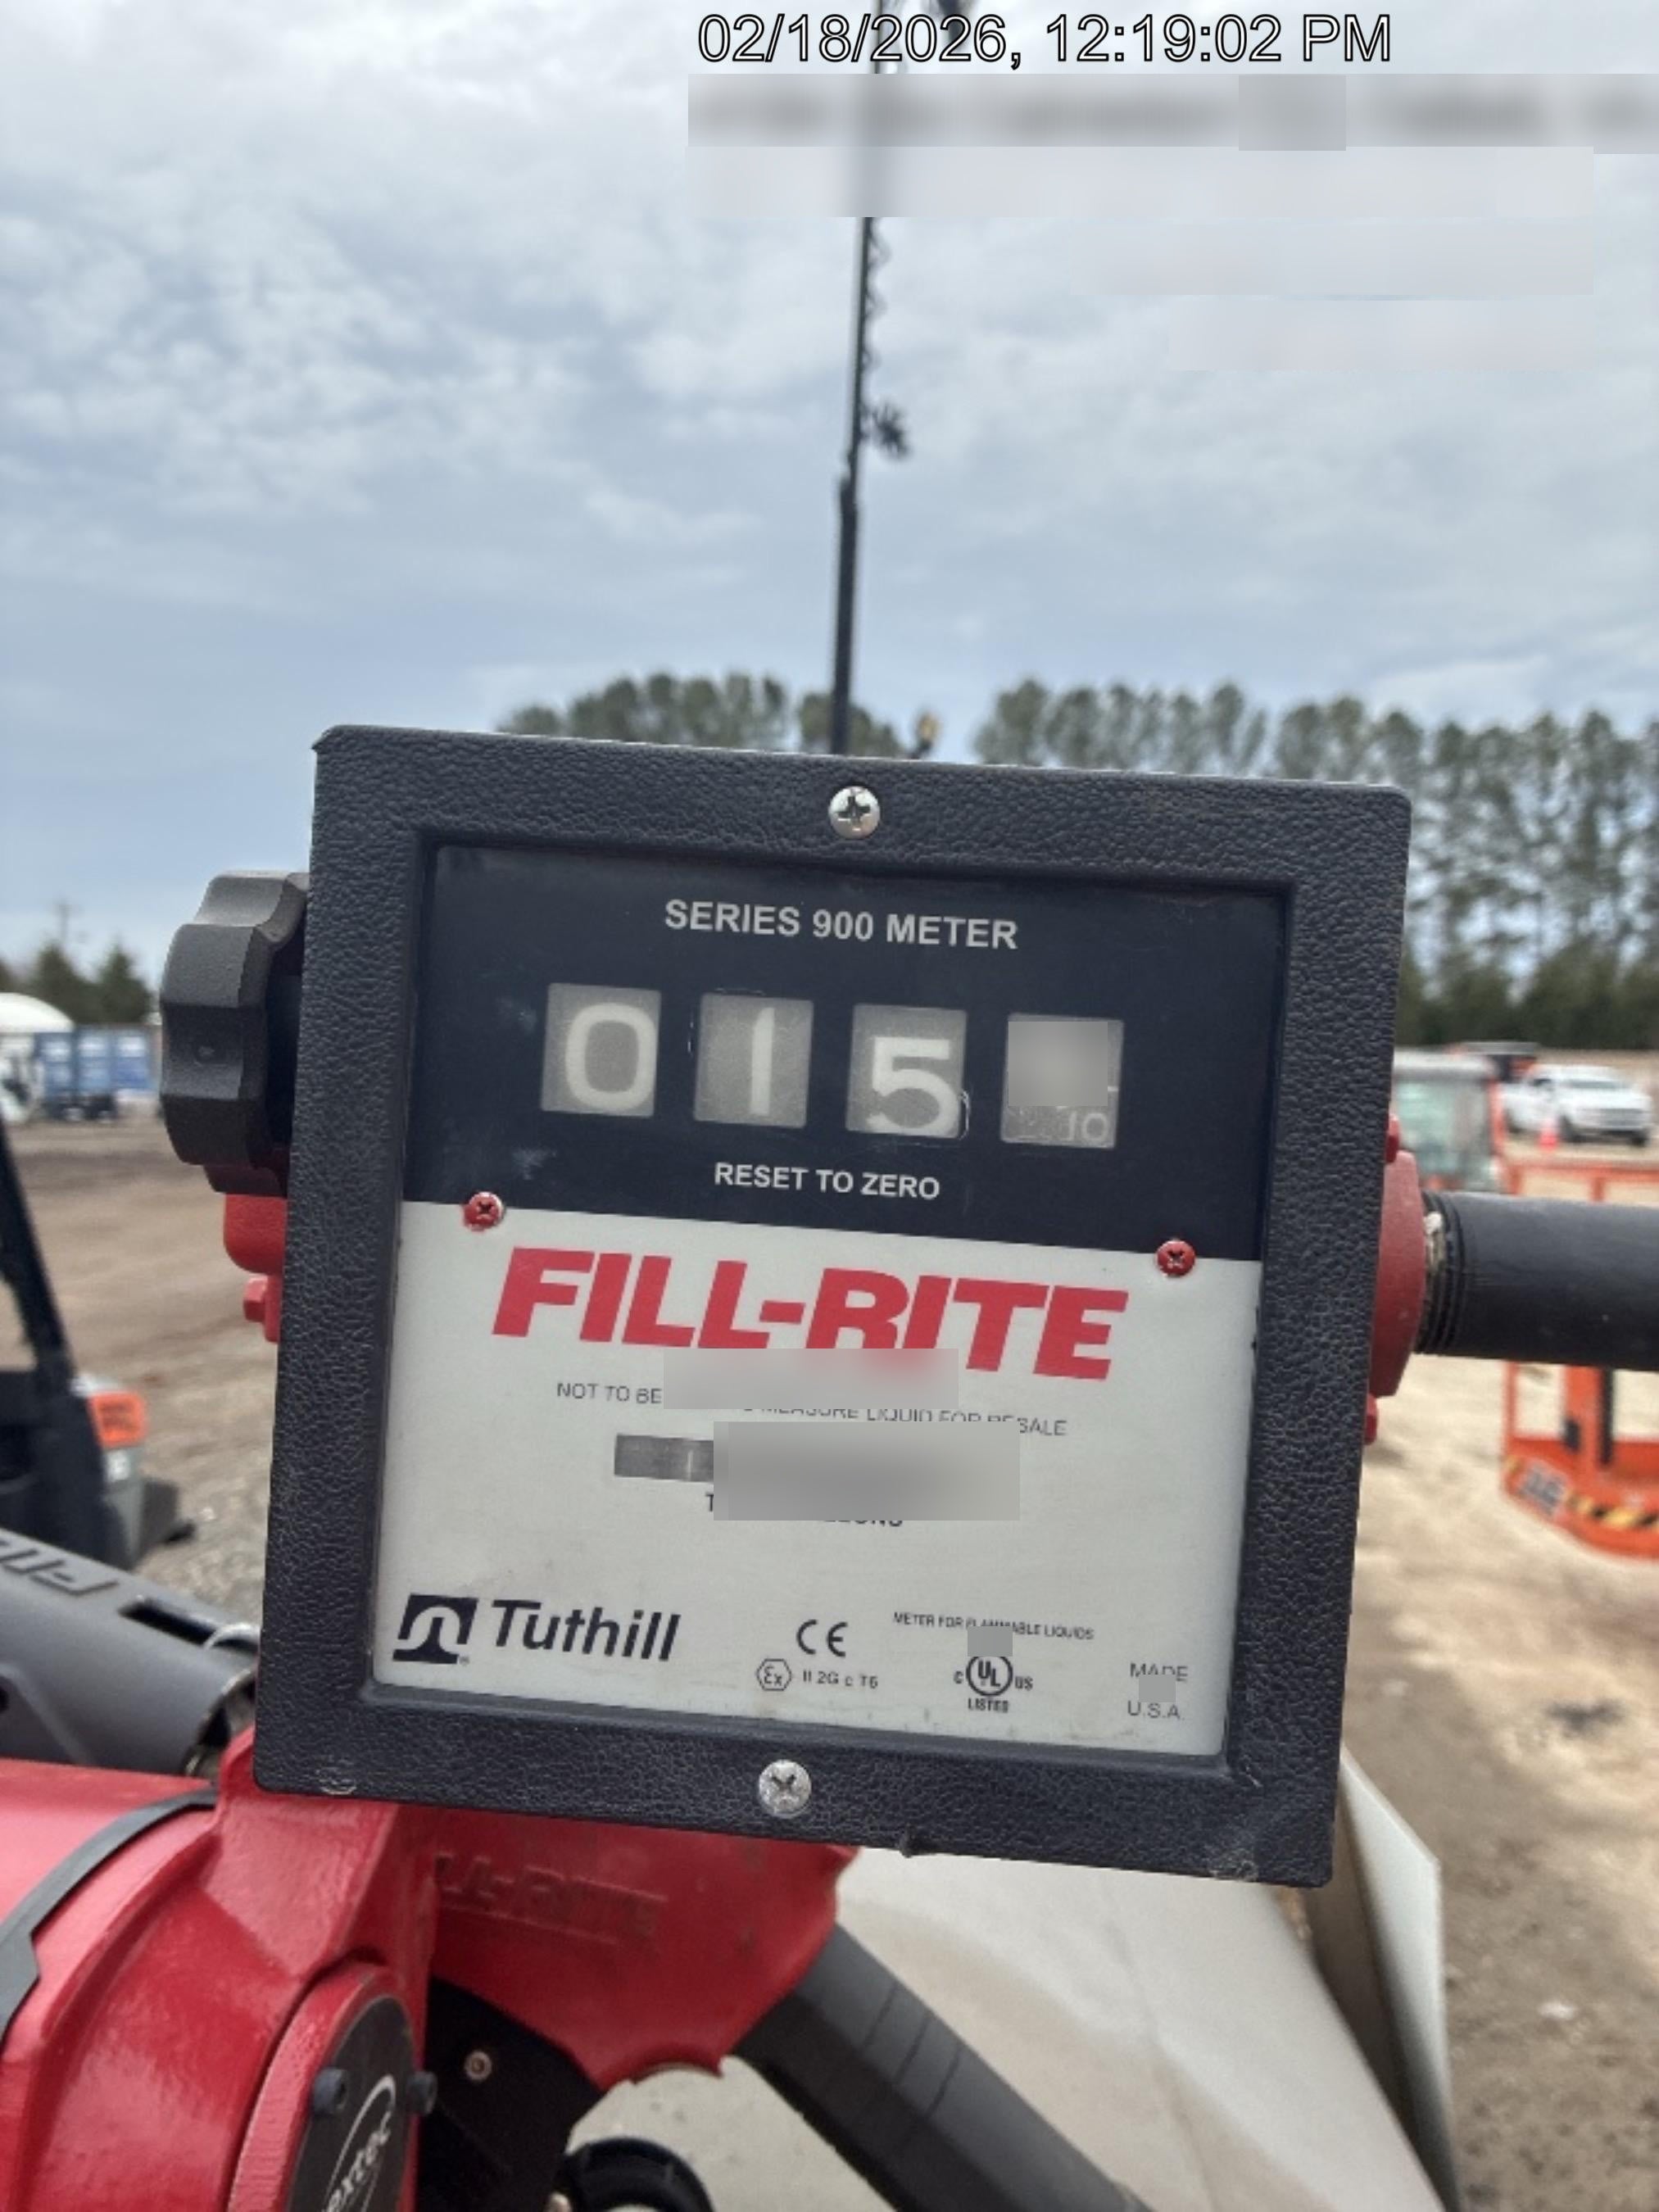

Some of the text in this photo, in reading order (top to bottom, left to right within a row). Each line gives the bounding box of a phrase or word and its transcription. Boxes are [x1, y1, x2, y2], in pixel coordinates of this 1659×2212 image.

[664, 899, 1018, 950] SERIES 900 METER
[714, 1162, 941, 1200] RESET TO ZERO
[492, 1246, 1129, 1381] FILL-RITE
[557, 1382, 662, 1403] NOT TO BE
[491, 1599, 681, 1661] Tuthill
[894, 1611, 934, 1627] METER
[1044, 1625, 1095, 1640] LIQUIDS
[978, 1661, 1000, 1687] UL
[968, 1698, 1009, 1713] LISTED
